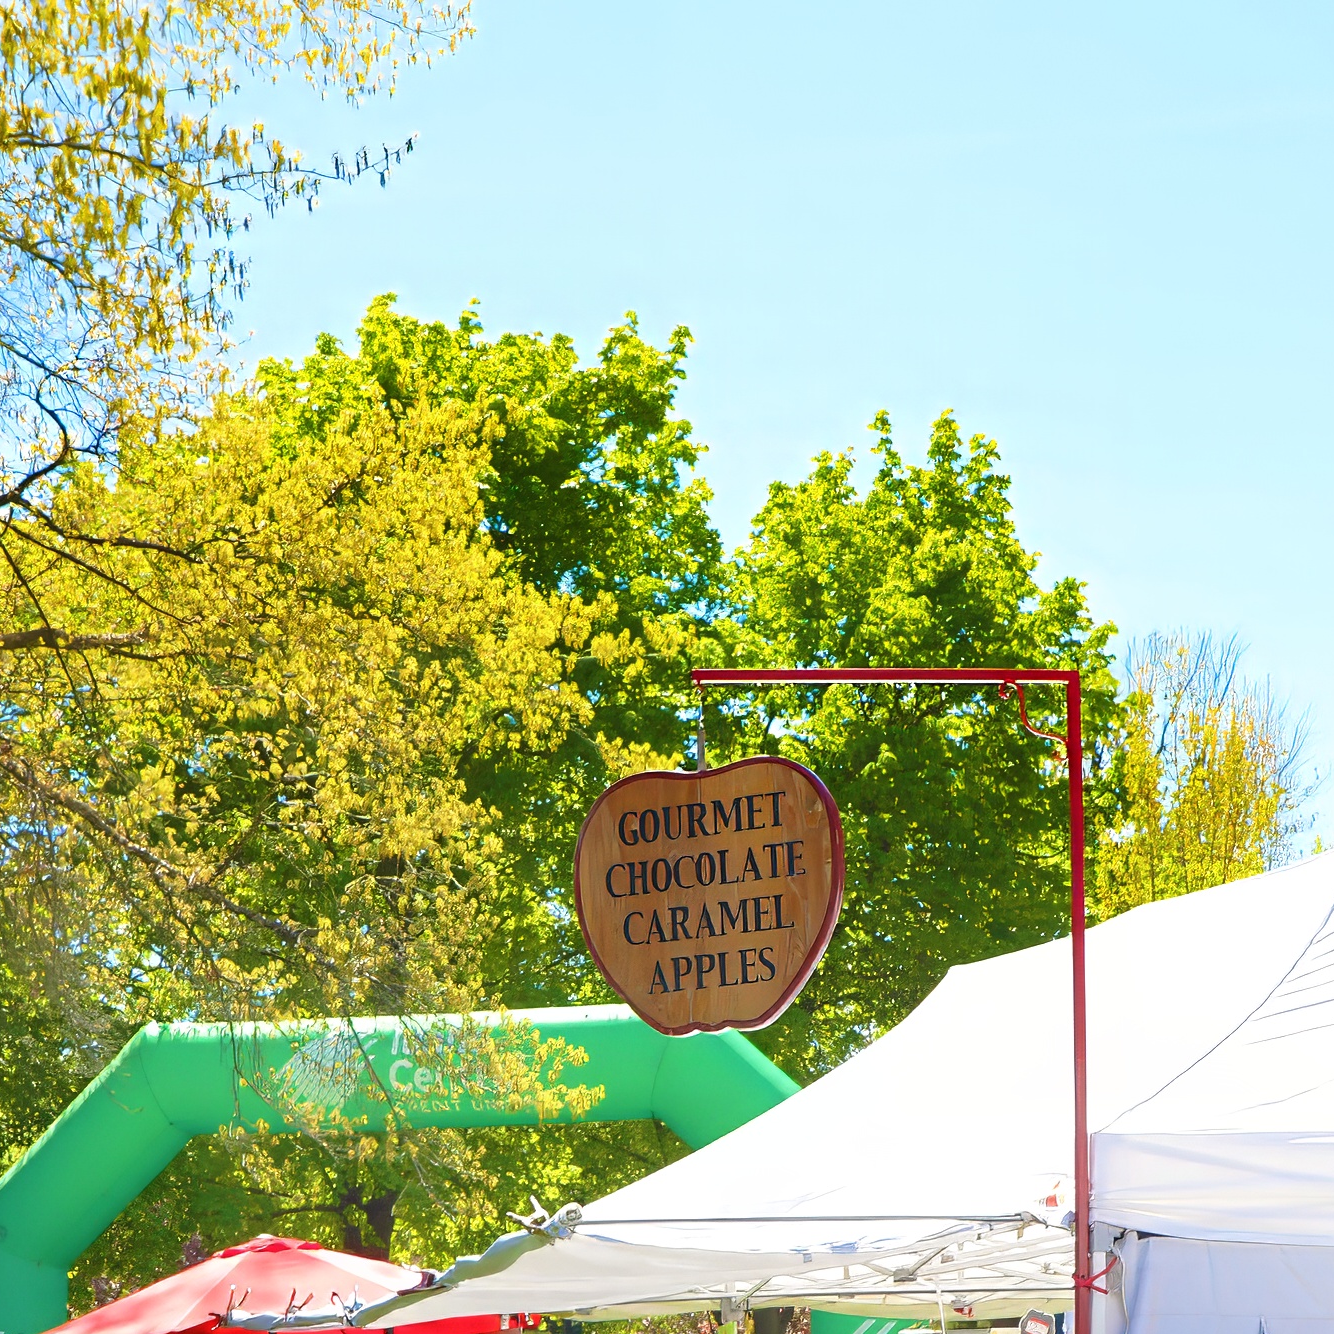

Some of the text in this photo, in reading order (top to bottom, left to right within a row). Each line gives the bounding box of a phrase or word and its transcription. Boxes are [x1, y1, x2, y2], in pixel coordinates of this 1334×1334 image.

[618, 791, 786, 846] GOURMET
[605, 840, 806, 898] CHOCOLATE
[623, 894, 795, 945] CARAMEL
[648, 947, 776, 995] APPLES
